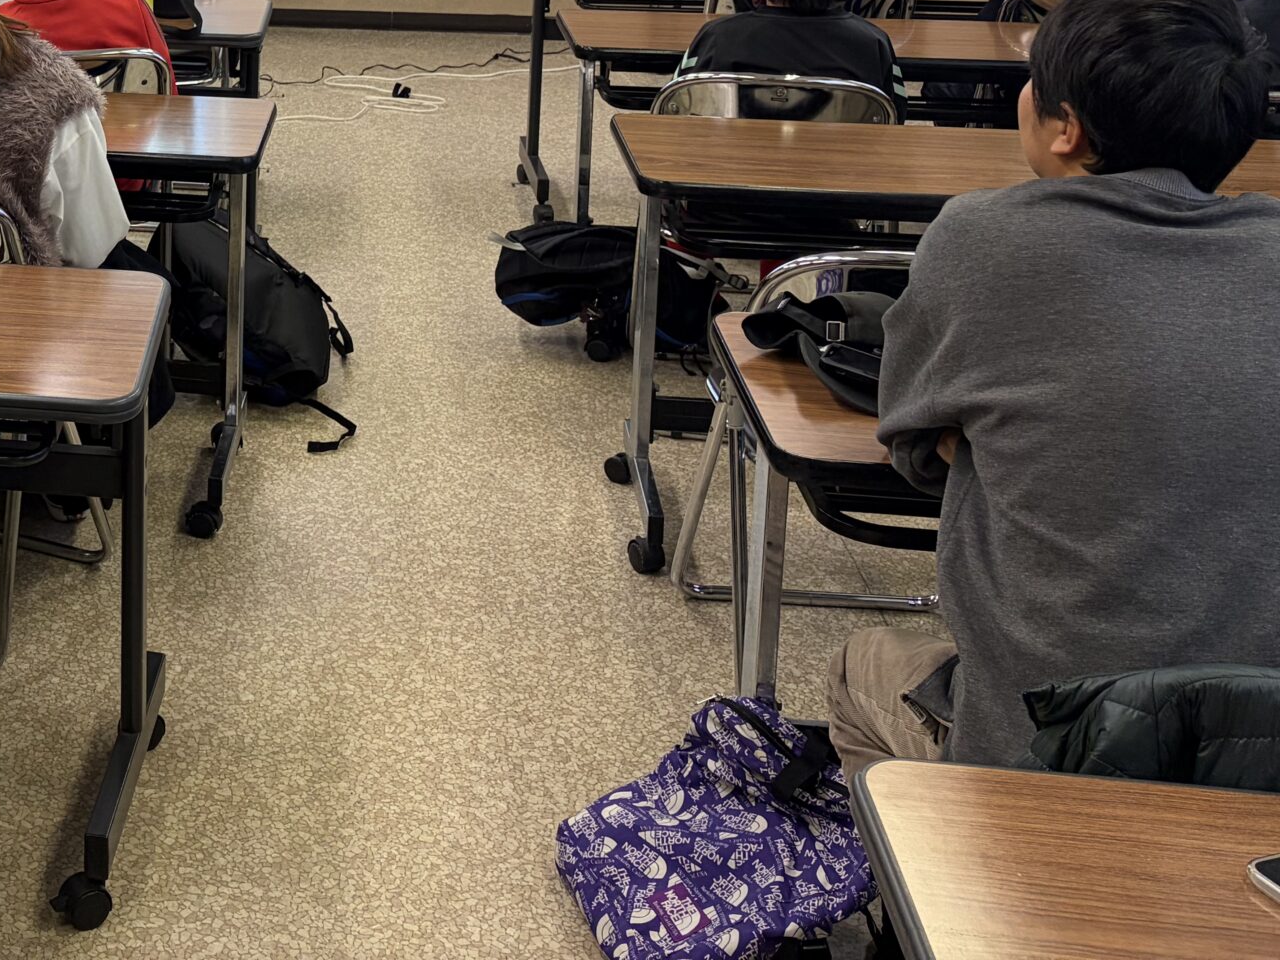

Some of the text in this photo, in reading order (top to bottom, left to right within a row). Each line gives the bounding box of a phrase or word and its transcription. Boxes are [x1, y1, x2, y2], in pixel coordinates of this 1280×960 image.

[621, 841, 652, 868] NORTH
[623, 852, 649, 873] FACE
[640, 843, 659, 864] THE
[727, 872, 745, 890] THE
[661, 899, 682, 923] FACE
[664, 889, 689, 919] NORTH
[682, 896, 697, 915] THE
